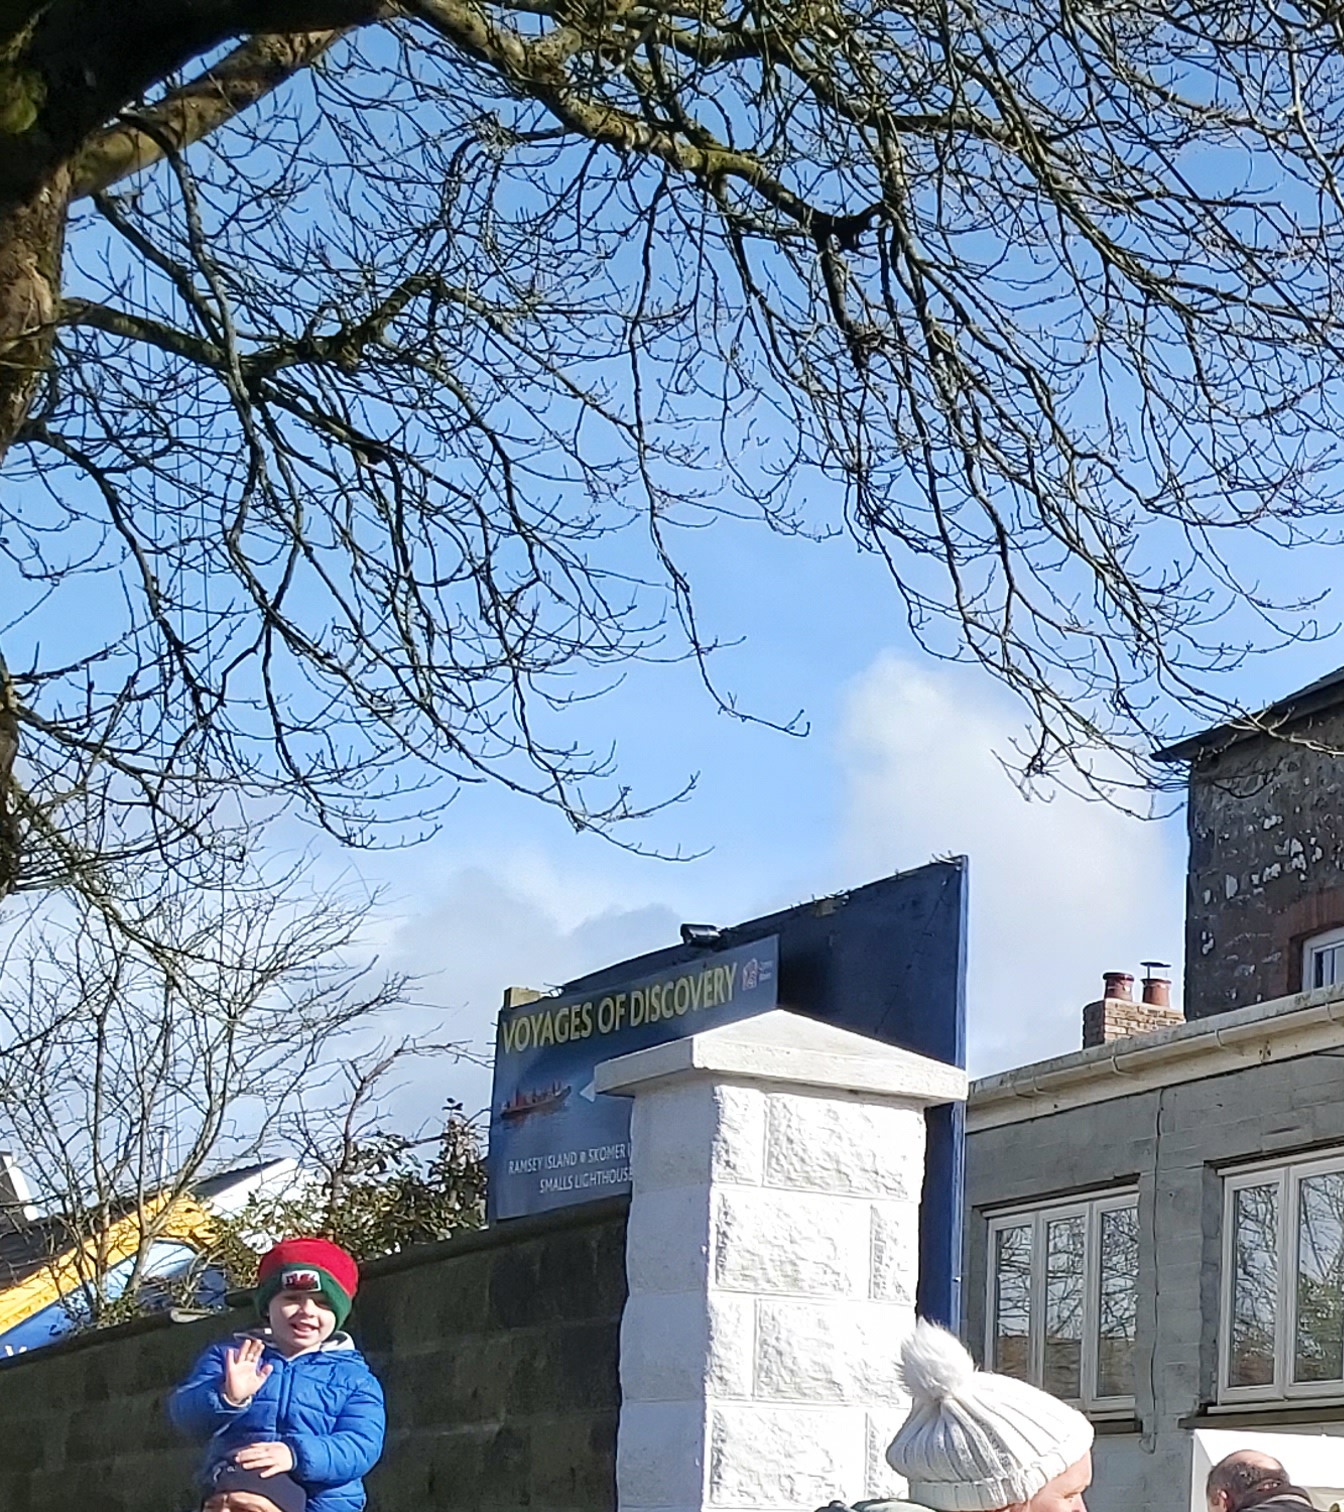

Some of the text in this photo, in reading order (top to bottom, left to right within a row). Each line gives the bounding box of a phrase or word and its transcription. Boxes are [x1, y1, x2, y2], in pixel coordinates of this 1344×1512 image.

[502, 1002, 592, 1054] VOYAGES
[597, 991, 626, 1034] OF
[630, 963, 737, 1027] DISCOVERY
[508, 1157, 542, 1175] RAMSEY
[544, 1151, 577, 1169] ISLAND
[588, 1143, 626, 1163] SKOMER
[540, 1174, 573, 1193] SMALLS
